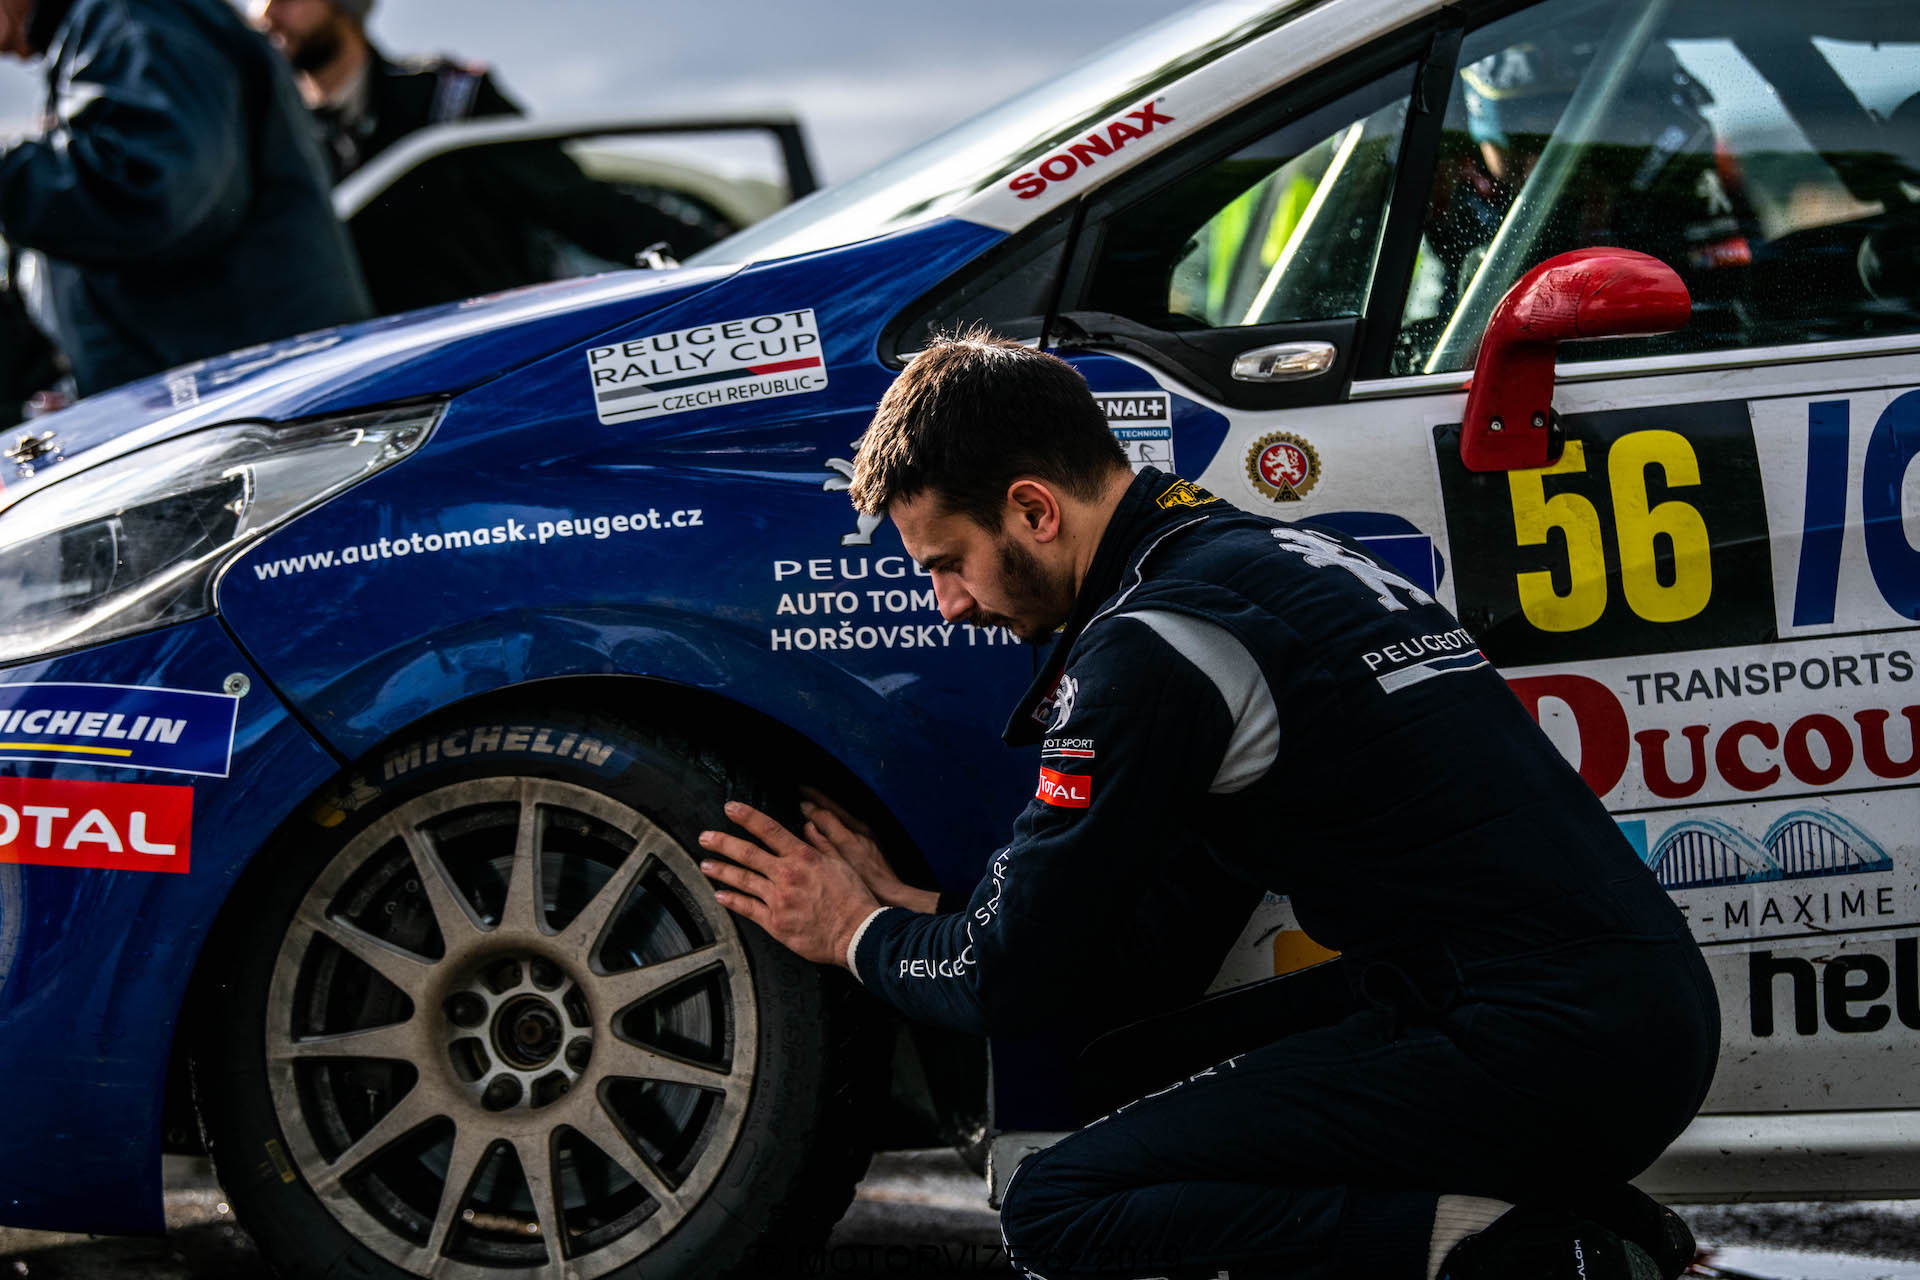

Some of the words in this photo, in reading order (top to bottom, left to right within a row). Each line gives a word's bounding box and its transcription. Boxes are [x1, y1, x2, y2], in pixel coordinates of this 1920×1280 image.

[1009, 101, 1176, 199] SONAX
[590, 310, 811, 364] PEUGEOT
[593, 349, 716, 386] RALLY
[730, 333, 816, 361] CUP
[662, 389, 721, 411] CZECH
[728, 375, 812, 401] REPUBLIC
[1122, 429, 1169, 438] TECHNIQUE
[254, 508, 703, 581] www.autotomask.peugeot.cz
[1508, 429, 1712, 632] 56
[776, 590, 859, 616] AUTO
[866, 589, 940, 613] TOM
[771, 620, 955, 651] HORŠOVSKÝ
[1627, 650, 1914, 706] TRANSPORTS
[384, 725, 616, 781] MICHELIN
[1062, 738, 1095, 749] SPORT
[1040, 775, 1086, 800] TOTAL
